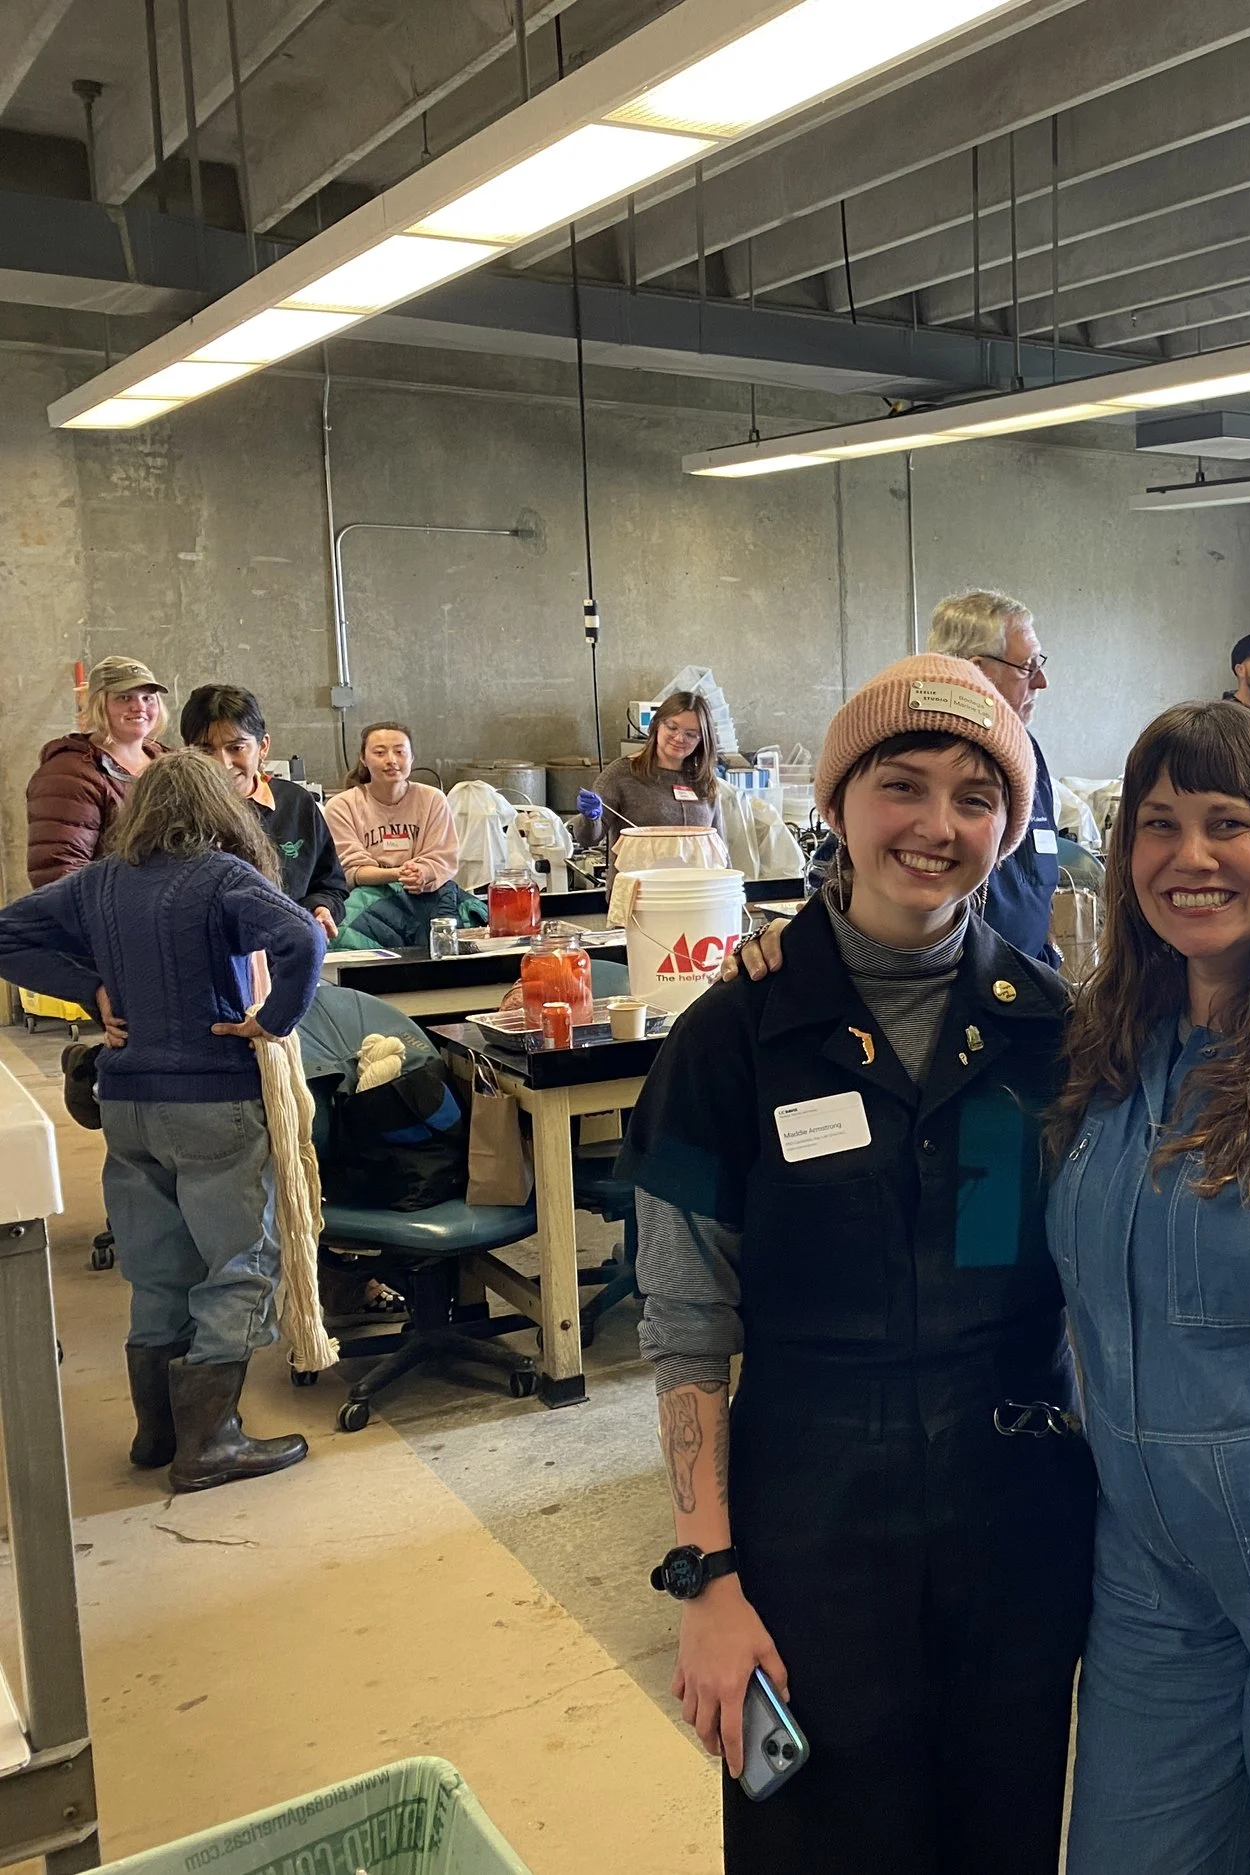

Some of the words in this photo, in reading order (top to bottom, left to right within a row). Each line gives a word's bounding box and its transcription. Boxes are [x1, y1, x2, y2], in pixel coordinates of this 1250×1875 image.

[656, 974, 675, 982] The
[679, 973, 708, 982] helpf
[783, 1129, 808, 1139] Maddie
[808, 1122, 842, 1134] Armstrong
